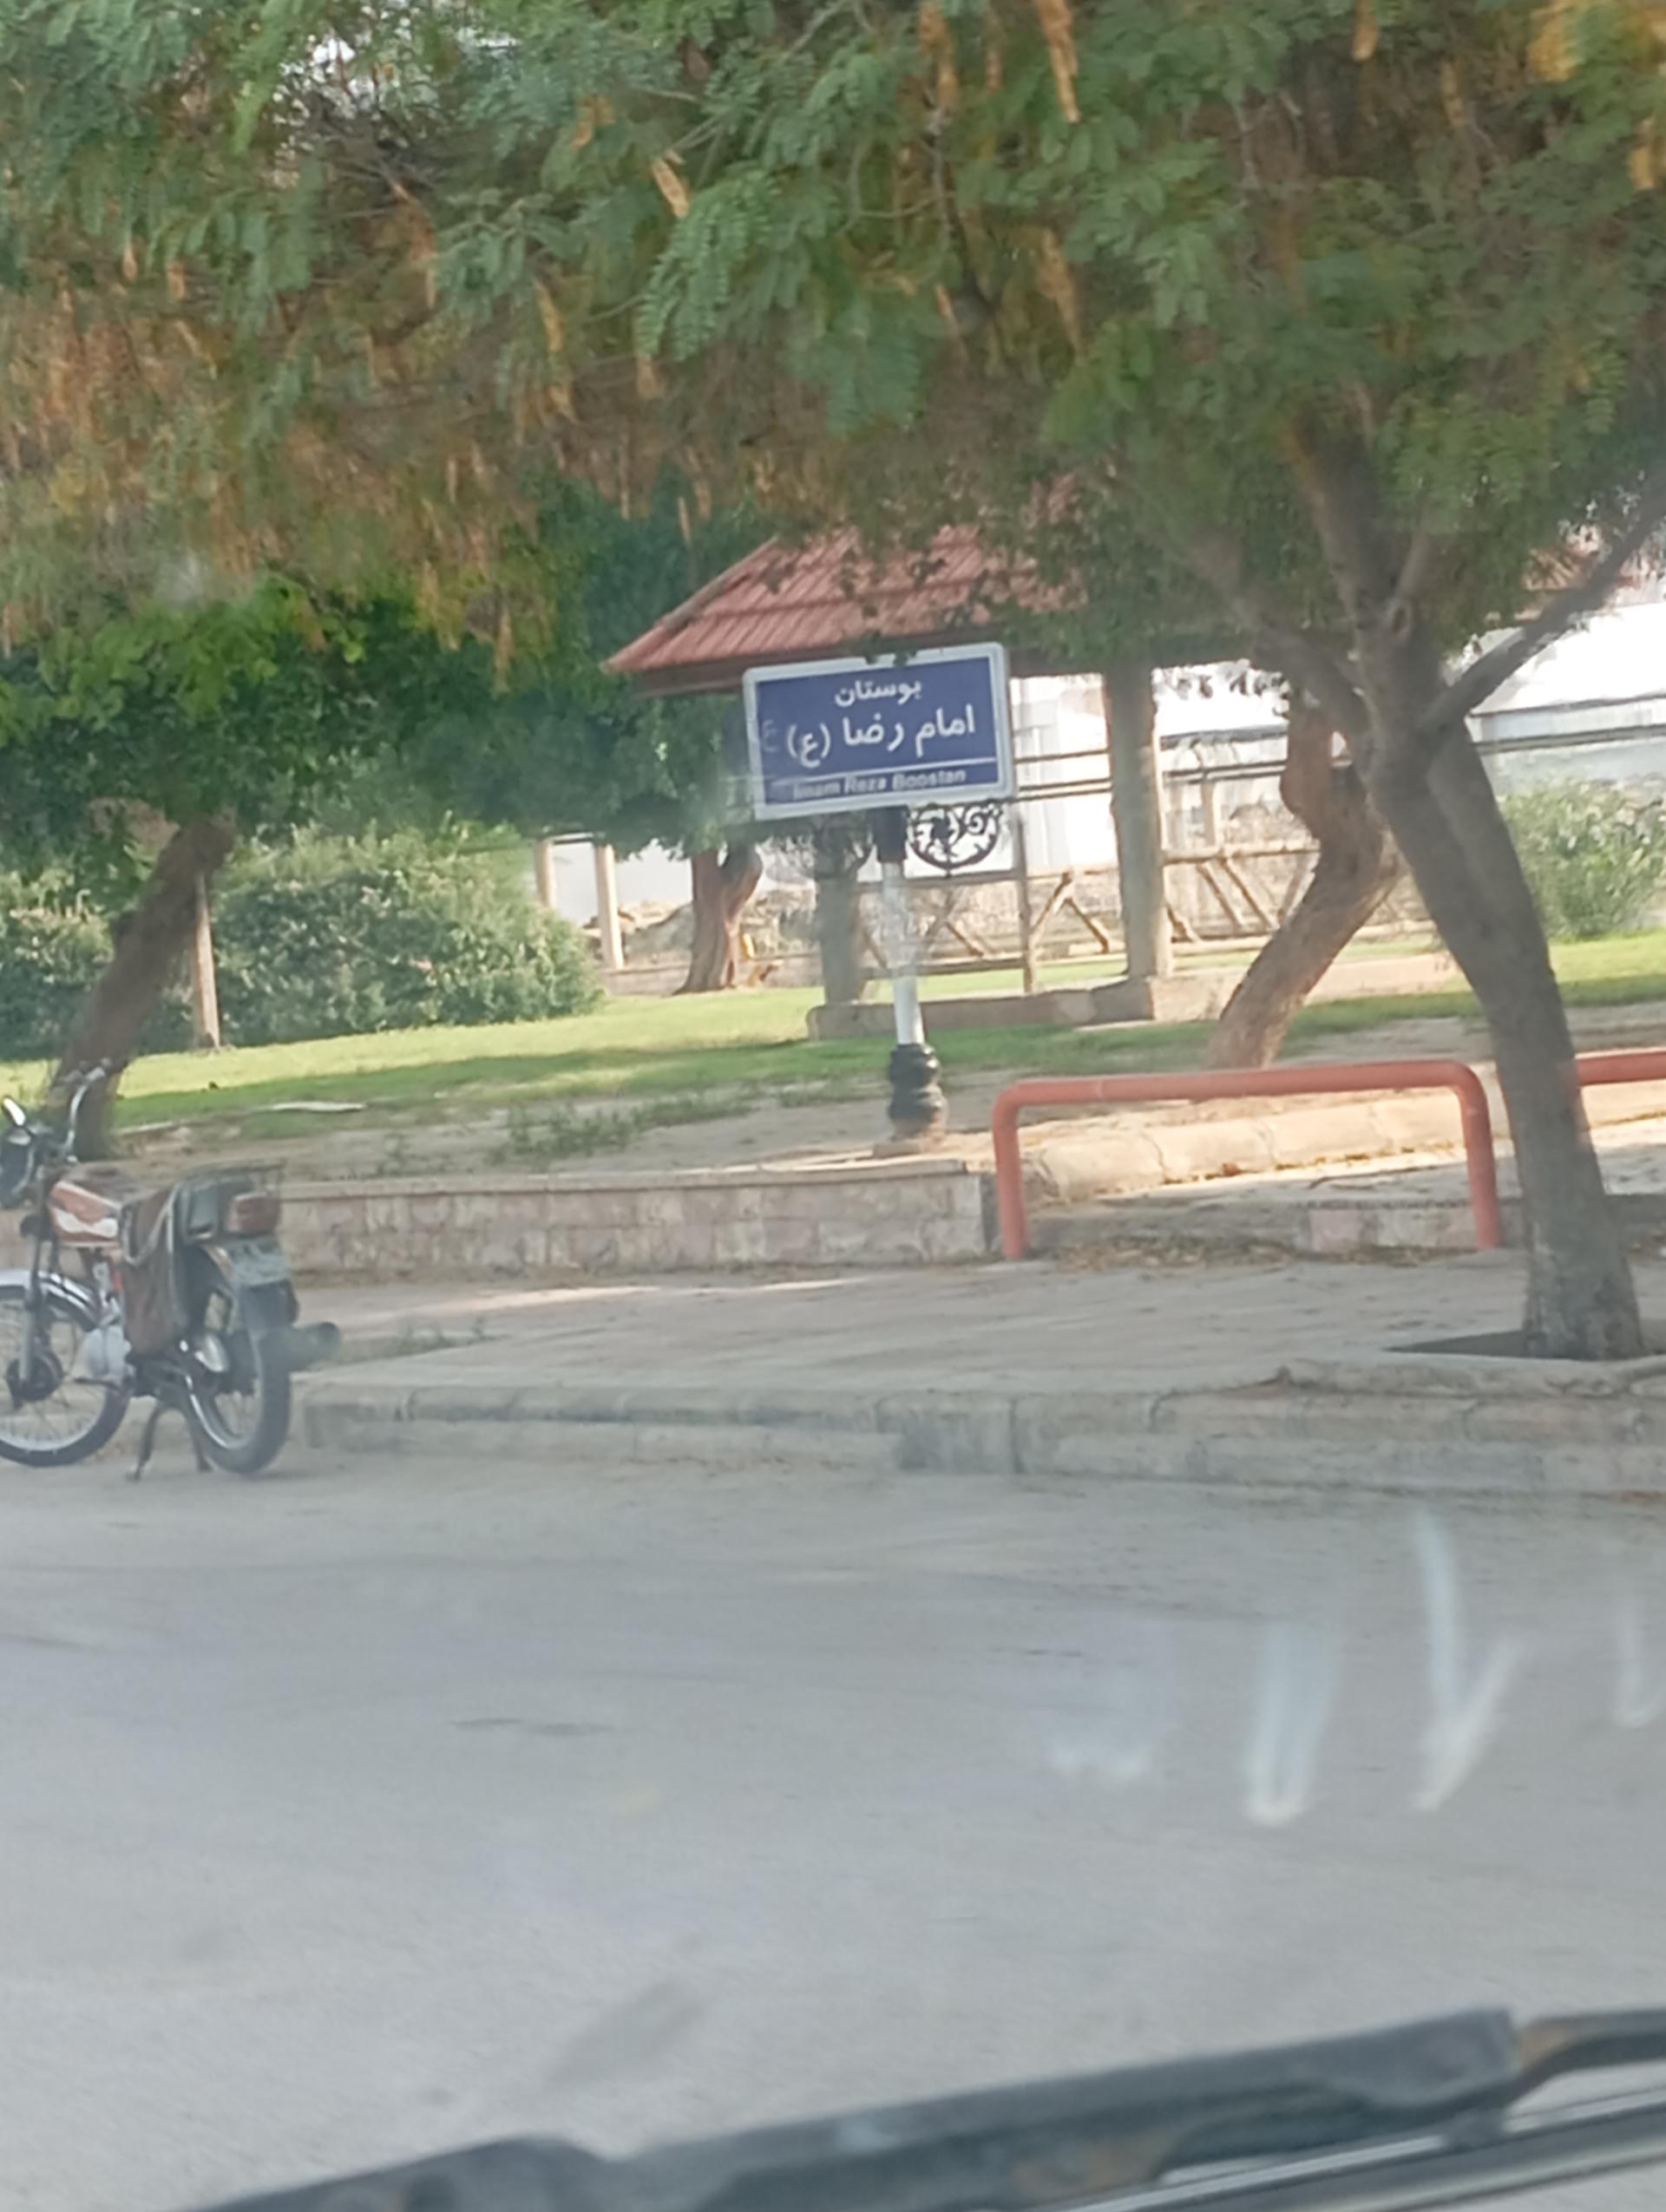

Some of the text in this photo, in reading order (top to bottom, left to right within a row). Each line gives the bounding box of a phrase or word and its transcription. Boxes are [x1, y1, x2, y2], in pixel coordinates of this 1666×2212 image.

[834, 678, 922, 707] بوستان
[786, 704, 975, 769] امام رضا (ع)
[844, 775, 887, 795] Reza
[892, 768, 967, 791] Boostan
